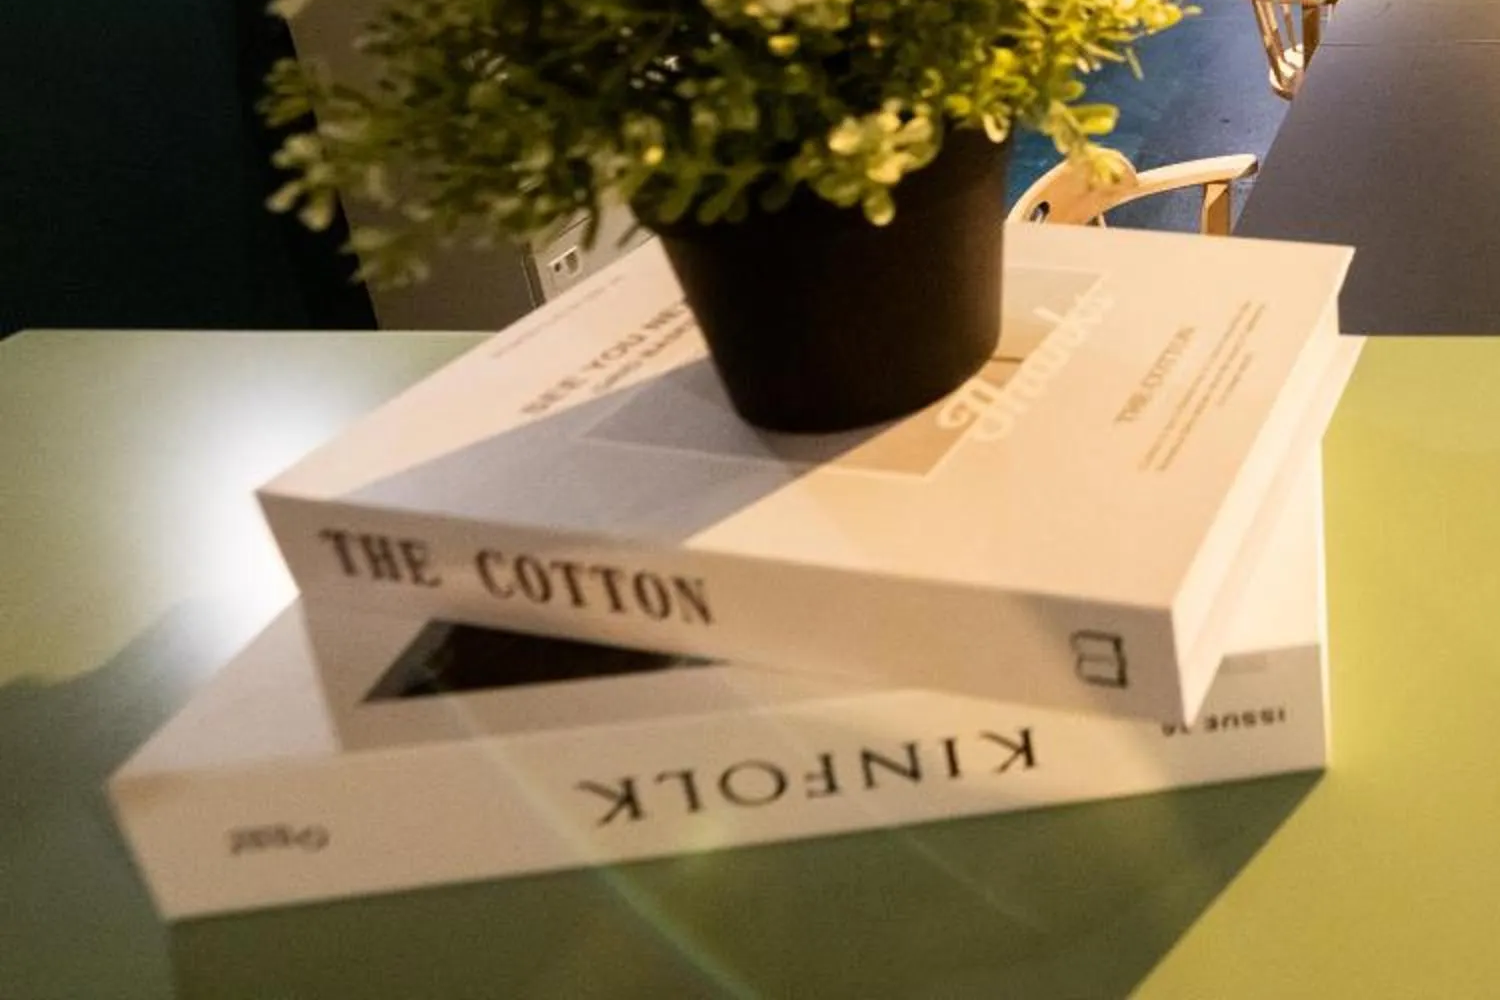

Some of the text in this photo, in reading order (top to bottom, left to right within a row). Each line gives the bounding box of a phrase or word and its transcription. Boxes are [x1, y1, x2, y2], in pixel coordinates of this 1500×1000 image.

[319, 529, 714, 626] THE COTTON
[1204, 706, 1286, 732] ISSUE
[574, 728, 1038, 828] KINFOLK
